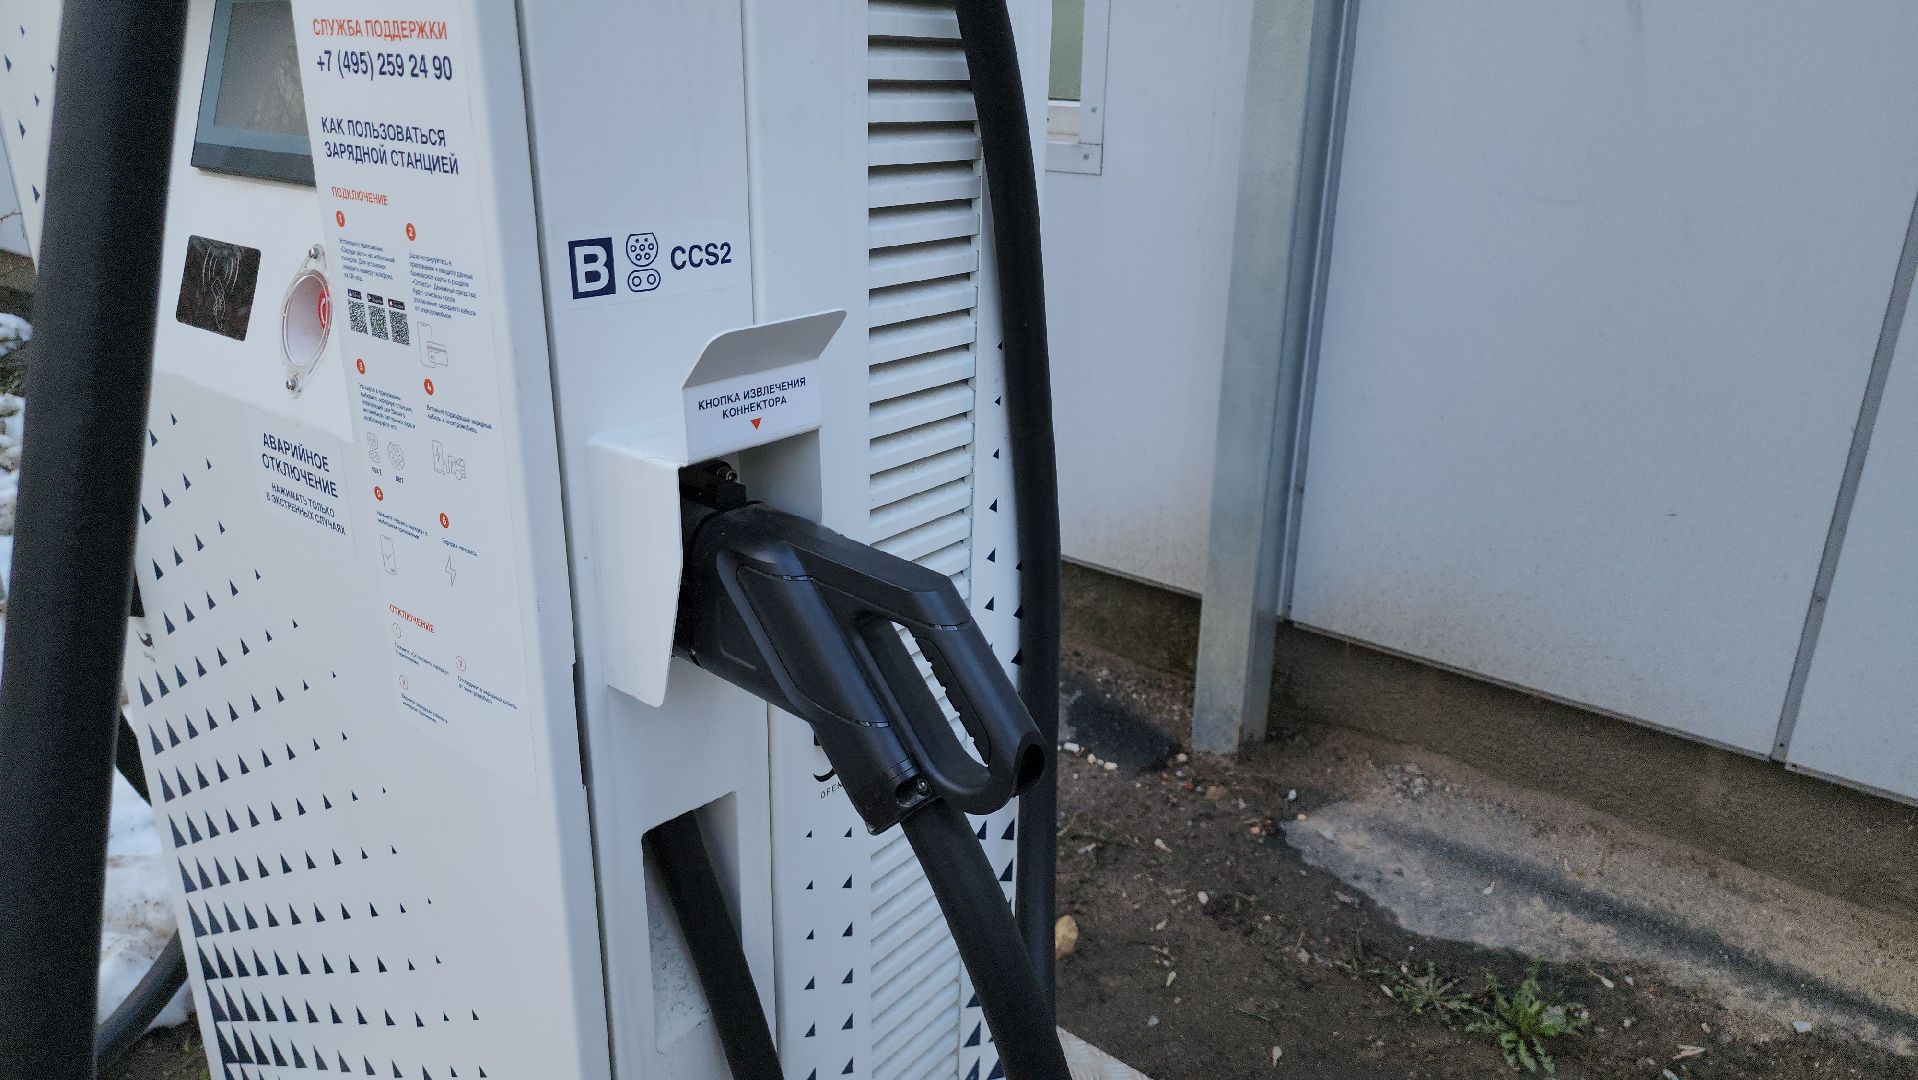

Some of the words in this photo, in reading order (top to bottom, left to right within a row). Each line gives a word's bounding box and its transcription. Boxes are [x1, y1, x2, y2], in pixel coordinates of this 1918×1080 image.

[313, 18, 363, 37] СЛУЖБА
[365, 19, 448, 41] ПОДДЕРЖКИ
[317, 50, 332, 71] +7
[338, 49, 374, 81] (495)
[377, 53, 405, 77] 259
[409, 54, 428, 79] 24
[432, 55, 453, 81] 90
[321, 117, 346, 136] КАК
[347, 119, 446, 147] ПОЛЬЗОВАТЬСЯ
[324, 141, 388, 165] ЗАРЯДНОЙ
[390, 150, 459, 175] СТАНЦИЕЙ
[331, 186, 388, 206] ПОДКЛЮЧЕНИЕ
[574, 245, 610, 293] B
[670, 242, 732, 271] CCS2
[698, 392, 741, 411] КНОПКА
[743, 376, 806, 400] ИЗВЛЕЧЕНИЯ
[722, 395, 787, 419] КОННЕКТОРА
[263, 432, 330, 473] АВАРИЙНОЕ
[262, 453, 338, 498] ОТКЛЮЧЕНИЕ
[271, 482, 307, 505] НАЖИМАТЬ
[308, 498, 335, 518] ТОЛЬКО
[271, 494, 314, 520] ЭКСТРЕННЫХ
[314, 514, 346, 535] СЛУЧАЯХ
